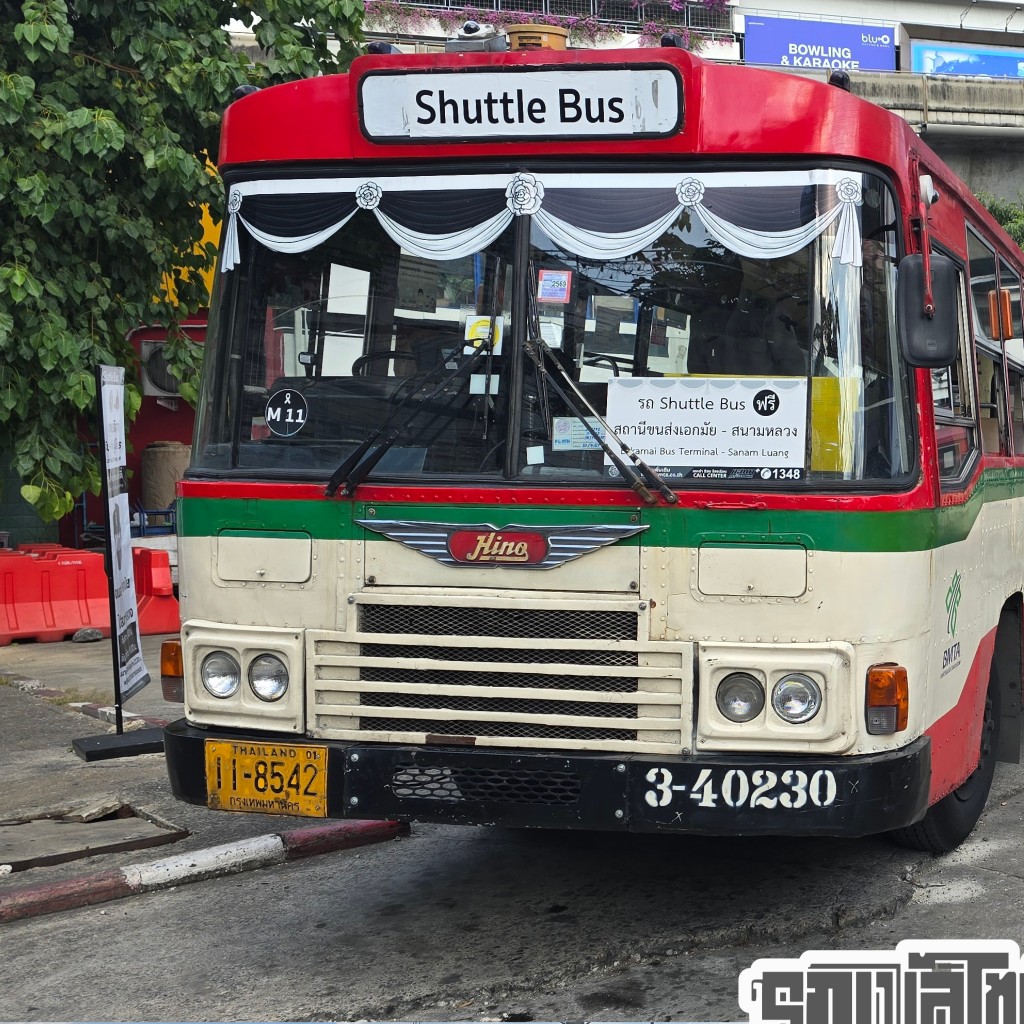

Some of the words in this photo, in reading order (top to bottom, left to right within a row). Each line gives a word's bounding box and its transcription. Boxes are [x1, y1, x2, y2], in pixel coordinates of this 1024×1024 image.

[788, 43, 852, 59] BOWLING
[781, 55, 790, 66] &
[793, 56, 860, 71] KARAOKE
[415, 89, 547, 126] Shuttle
[558, 87, 626, 123] Bus
[638, 398, 654, 410] รถ
[659, 396, 715, 410] Shuttle
[720, 397, 746, 411] Bus
[756, 393, 776, 412] ฟรี
[267, 406, 282, 422] M
[285, 408, 305, 423] 11
[613, 421, 717, 437] สถานีขนส่งเอกมัย
[731, 423, 798, 437] สนามหลวง
[620, 446, 657, 456] Ekamai
[659, 447, 676, 456] Bus
[679, 447, 719, 456] Terminal
[728, 448, 757, 456] Sanam
[761, 448, 789, 459] Luang
[772, 468, 801, 480] 1348
[466, 532, 529, 562] Hino
[232, 745, 297, 758] THAILAND
[216, 756, 319, 797] 11-8542
[644, 767, 838, 811] 3-40230
